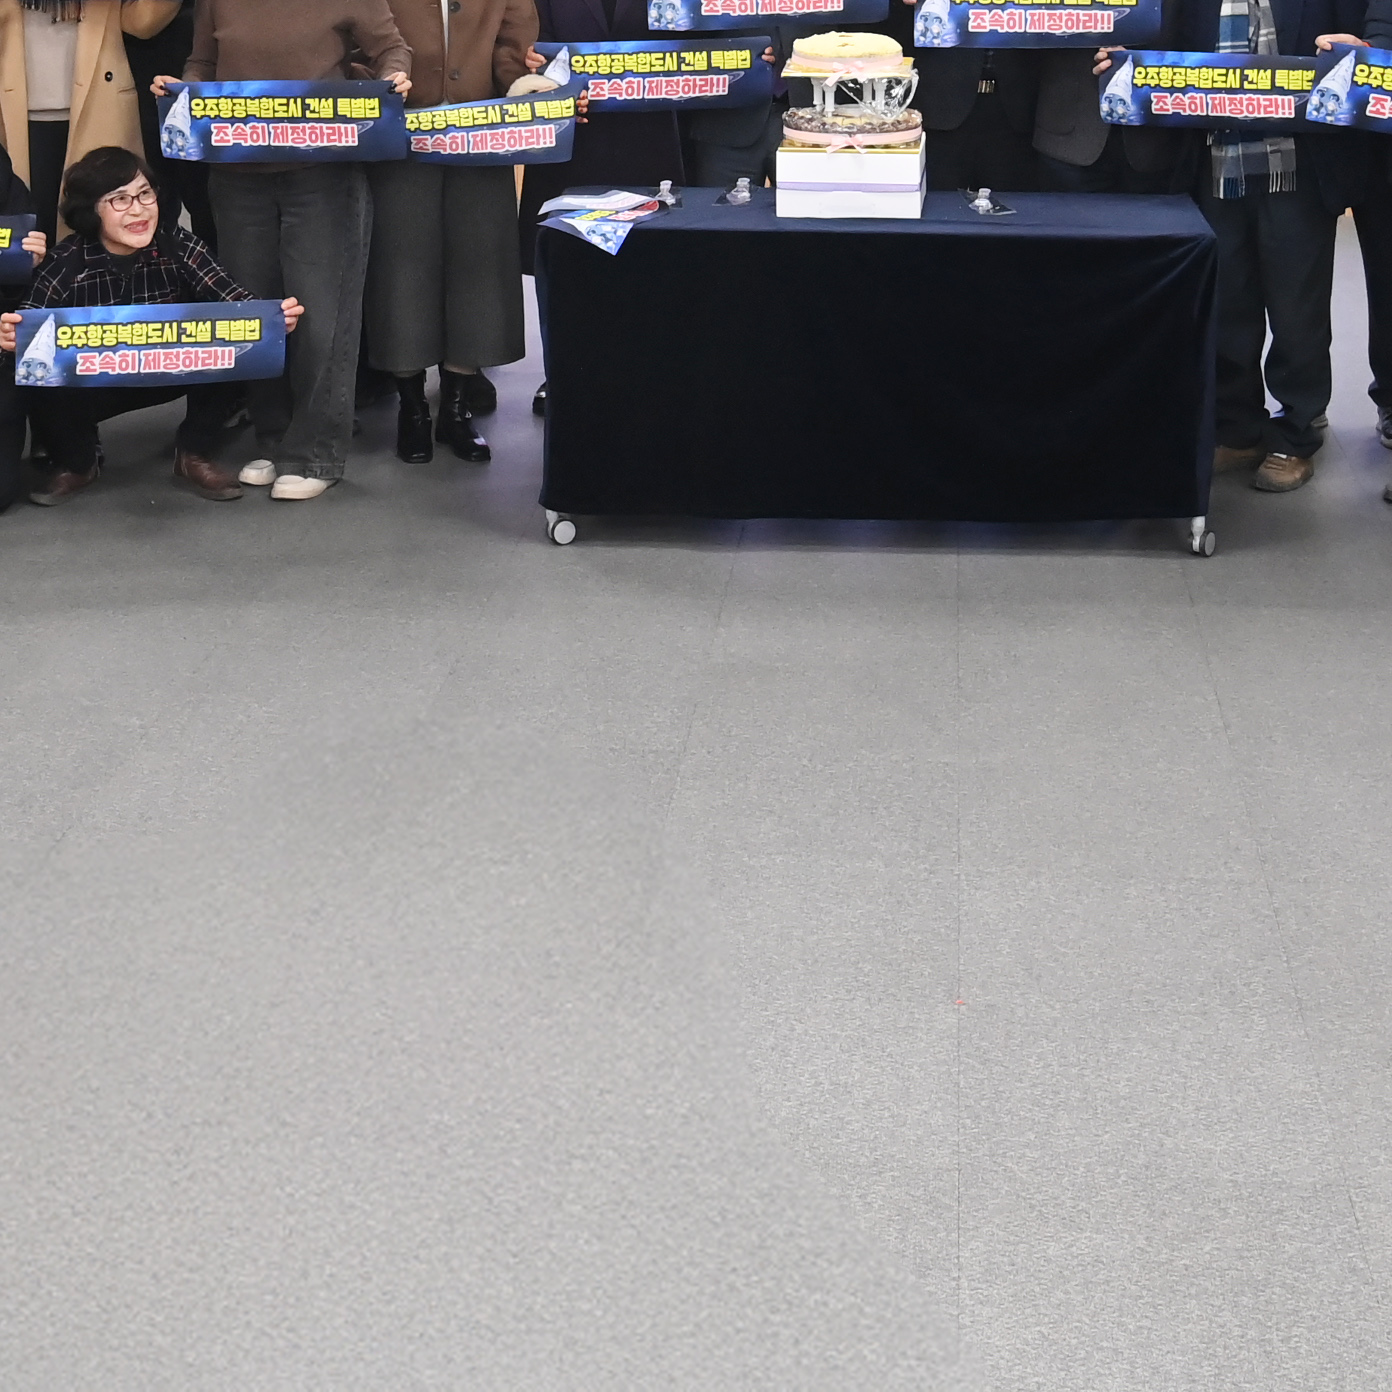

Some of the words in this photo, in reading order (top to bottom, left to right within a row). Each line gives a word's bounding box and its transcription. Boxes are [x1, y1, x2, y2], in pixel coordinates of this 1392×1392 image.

[968, 9, 1026, 32] 조속히
[1025, 10, 1114, 34] 제정하라!!
[571, 52, 678, 75] 우주항공복합도시
[680, 51, 708, 72] 건설
[711, 49, 751, 70] 특별법
[588, 78, 643, 101] 조속히
[642, 75, 729, 99] 제정하라!!
[1133, 66, 1241, 89] 우주항공복합도시
[1244, 68, 1272, 90] 건설
[1275, 69, 1316, 91] 특별법
[191, 97, 303, 119] 우주항공복합도시
[305, 97, 334, 119] 건설
[337, 97, 380, 119] 특별법
[503, 102, 533, 123] 건설
[534, 97, 576, 119] 특별법
[1152, 93, 1207, 115] 조속히
[1206, 94, 1296, 118] 제정하라!!
[211, 123, 270, 146] 조속히
[269, 123, 359, 148] 제정하라!!
[411, 132, 467, 154] 조속히
[469, 124, 556, 153] 제정하라!!
[57, 322, 178, 348] 우주항공복합도시
[182, 320, 212, 343] 건설
[216, 319, 261, 342] 특별법
[76, 351, 139, 375] 조속히
[140, 347, 235, 373] 제정하라!!
